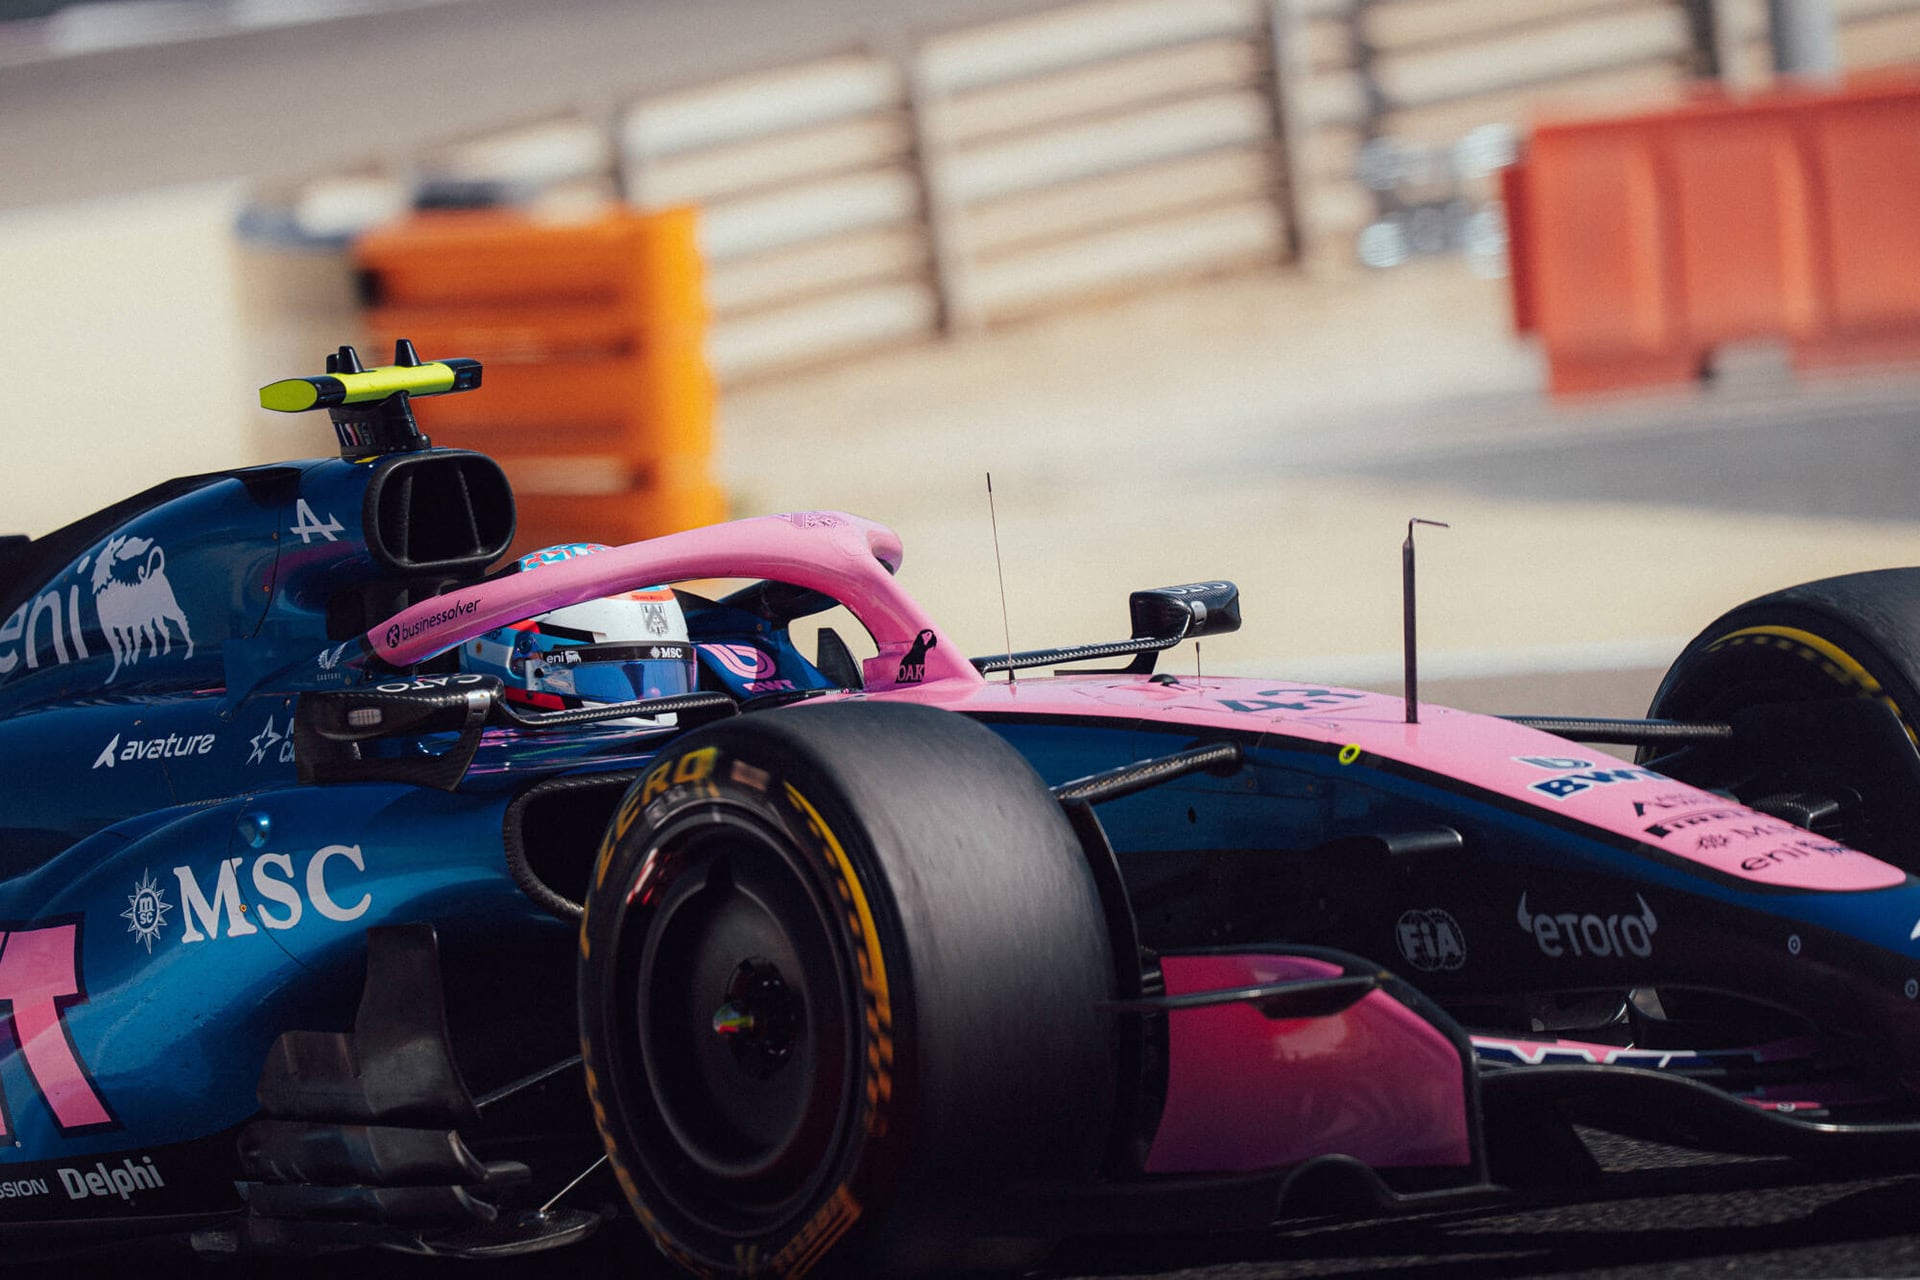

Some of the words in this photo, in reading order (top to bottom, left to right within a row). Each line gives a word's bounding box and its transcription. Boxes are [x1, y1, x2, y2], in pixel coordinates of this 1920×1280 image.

[401, 598, 481, 641] businessolver
[546, 652, 565, 664] eni
[660, 647, 682, 659] MSC
[898, 663, 925, 682] OAK
[120, 732, 216, 761] avature
[173, 844, 371, 944] MSC
[57, 1155, 165, 1200] Delphi
